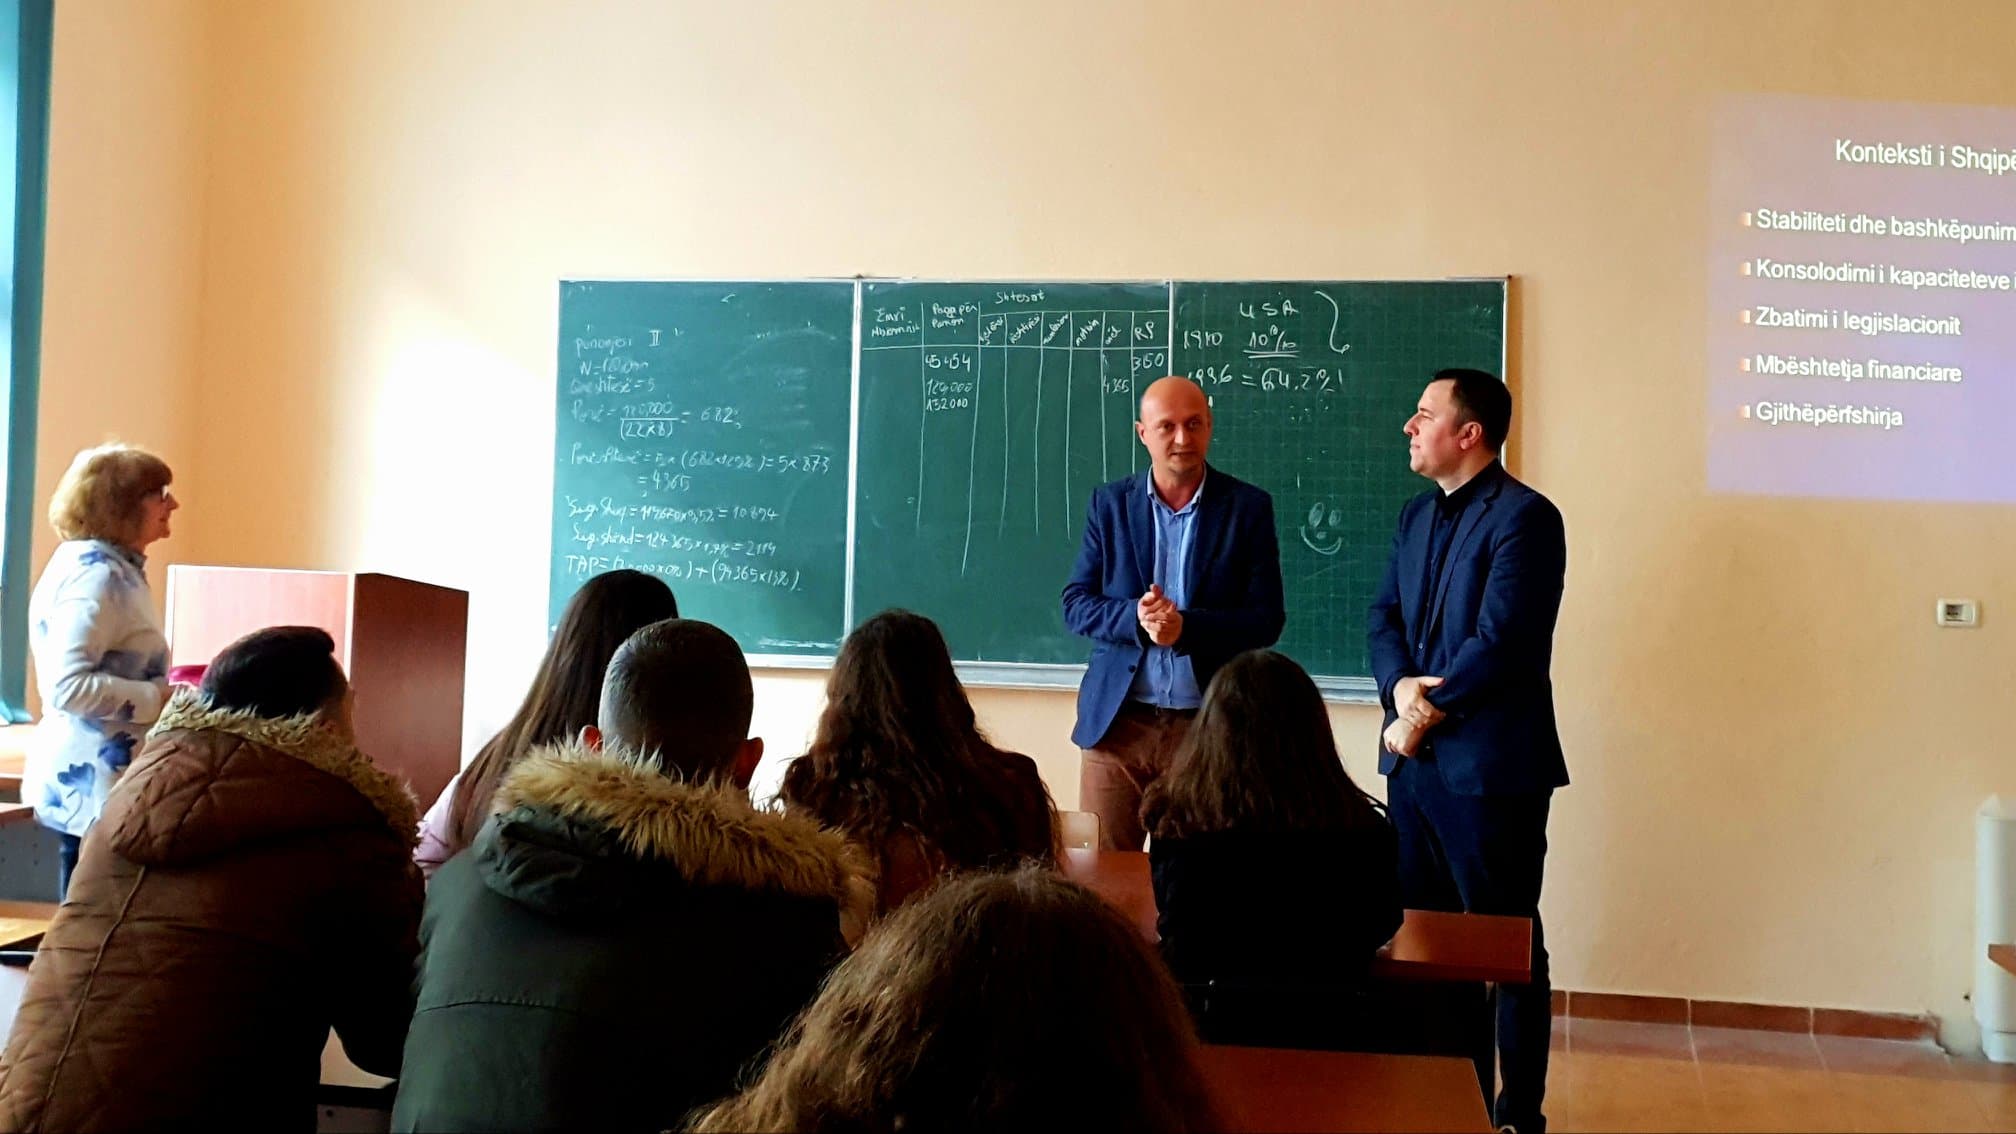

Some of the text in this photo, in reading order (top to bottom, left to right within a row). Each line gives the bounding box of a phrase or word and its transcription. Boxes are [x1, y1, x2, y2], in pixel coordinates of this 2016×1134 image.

[1835, 139, 1932, 167] Konteksti
[1939, 145, 1945, 167] i
[1756, 208, 2016, 244] Stabiliteti dhe bashkëpunim
[1756, 258, 1875, 283] Konsolodimi
[1879, 264, 1884, 284] i
[1889, 265, 2010, 290] kapaciteteve
[1239, 299, 1300, 319] USA
[1755, 306, 1961, 335] Zbatimi i legjislacionit
[1756, 354, 1962, 382] Mbështetja financiare
[1755, 401, 1903, 430] Gjithëpërfshirja
